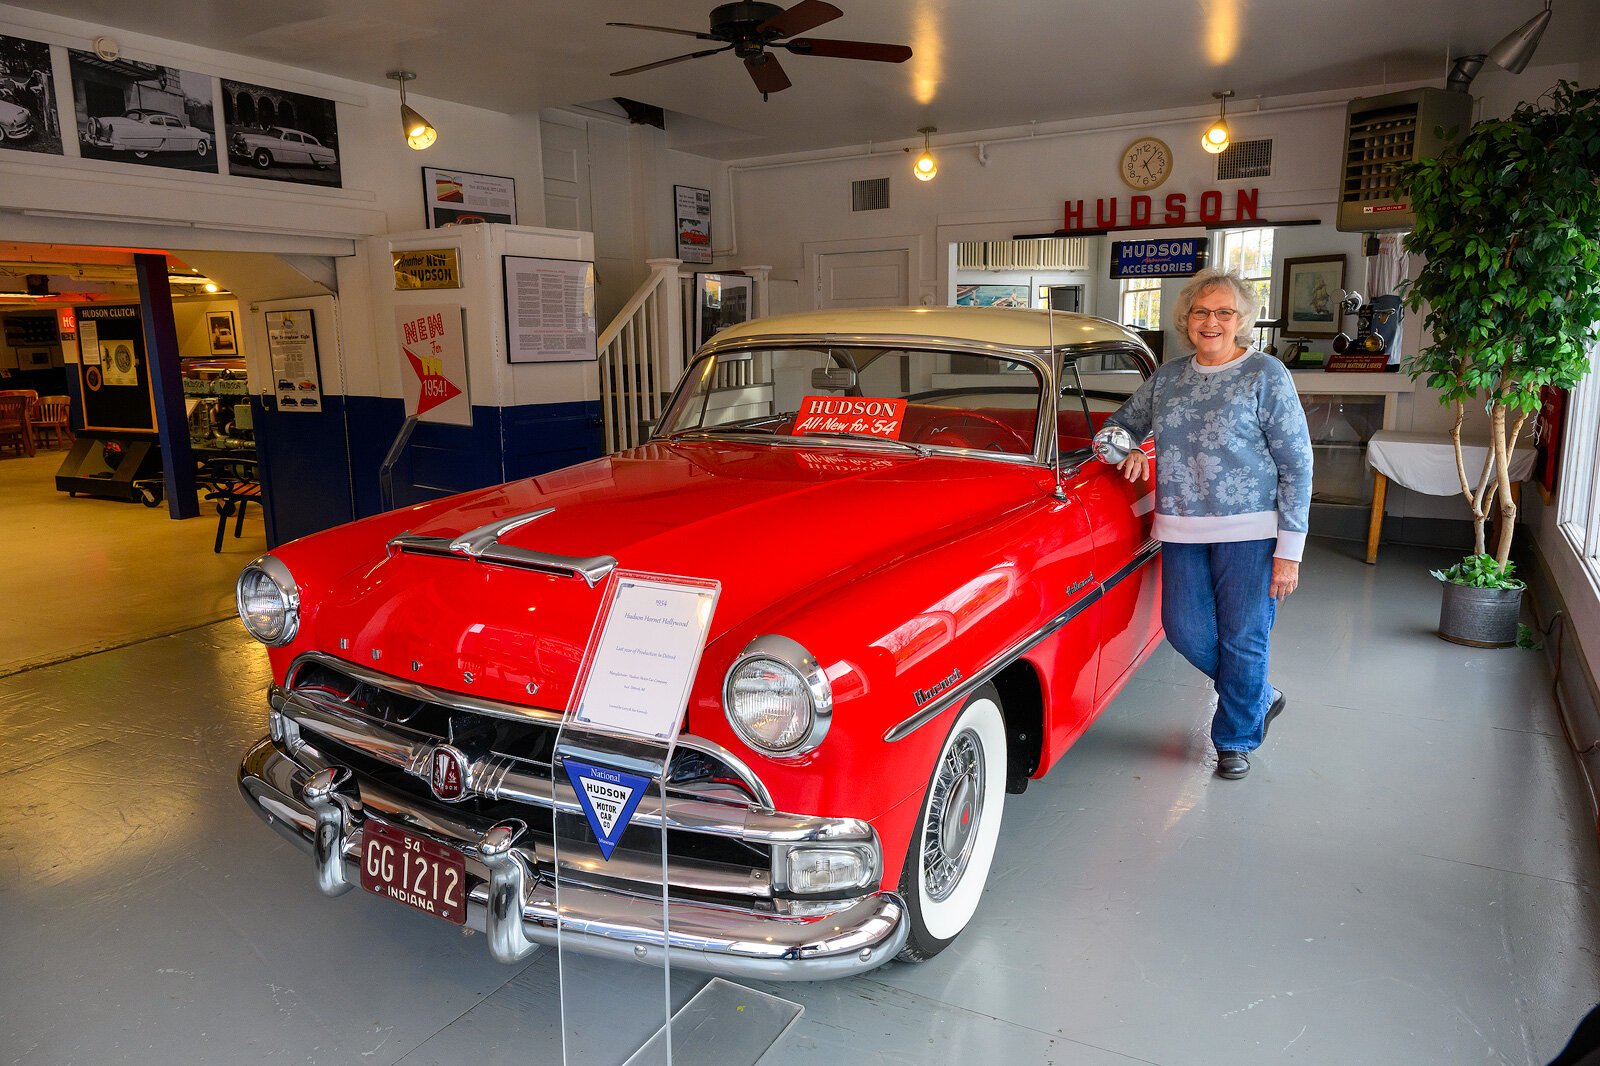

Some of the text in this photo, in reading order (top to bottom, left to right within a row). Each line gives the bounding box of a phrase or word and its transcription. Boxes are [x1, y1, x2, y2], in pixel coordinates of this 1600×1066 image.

[1142, 144, 1151, 152] 12
[1157, 151, 1163, 159] 2
[1129, 154, 1138, 162] 10
[1159, 159, 1165, 167] 3
[1128, 162, 1133, 170] 9
[1130, 170, 1135, 178] 8
[1143, 177, 1149, 185] 6
[1151, 173, 1157, 181] 5
[1064, 188, 1259, 230] HUDSON
[1122, 242, 1193, 259] HUDSON
[397, 253, 446, 269] Another NEW
[1121, 262, 1193, 275] ACCESSORIES
[410, 268, 452, 282] HUDSON
[82, 308, 135, 318] HUDSON CLUTCH
[403, 312, 445, 345] NEW
[430, 340, 443, 355] For
[423, 379, 447, 397] 1954!
[808, 400, 897, 418] HUDSON
[797, 416, 899, 435] All-New for '54
[624, 613, 690, 629] Hudson Hornet Hollywood
[913, 667, 963, 706] Hornet
[591, 768, 621, 783] National
[586, 783, 626, 800] HUDSON
[596, 802, 617, 814] MOTOR
[600, 812, 612, 822] CAR
[603, 821, 610, 829] CO
[404, 837, 420, 853] 54
[367, 840, 458, 908] GG 1212
[387, 885, 435, 913] INDIANA
